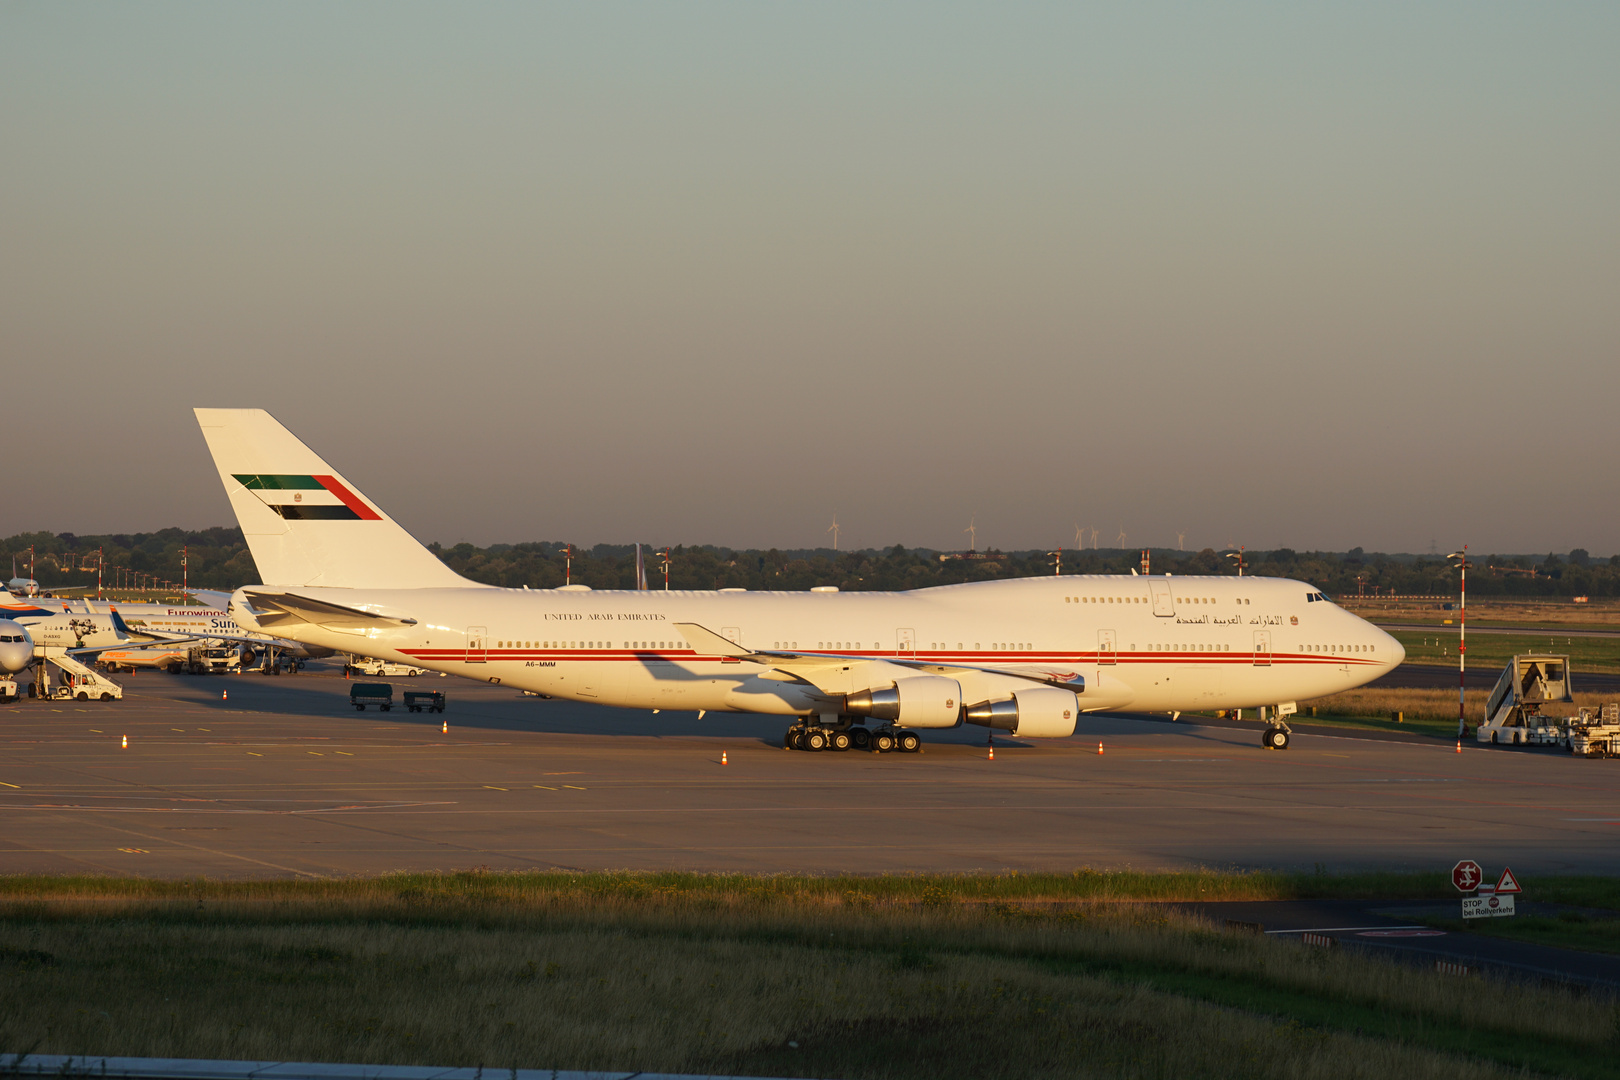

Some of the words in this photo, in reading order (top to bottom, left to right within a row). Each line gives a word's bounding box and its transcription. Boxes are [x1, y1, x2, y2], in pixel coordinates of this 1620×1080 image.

[544, 613, 582, 621] UNITED
[587, 613, 613, 621] ARAB
[618, 613, 666, 621] EMIRATES
[1213, 614, 1242, 628] العربية
[211, 618, 238, 629] Sun
[1463, 900, 1482, 908] STOP
[1475, 907, 1513, 915] Rollverkehr
